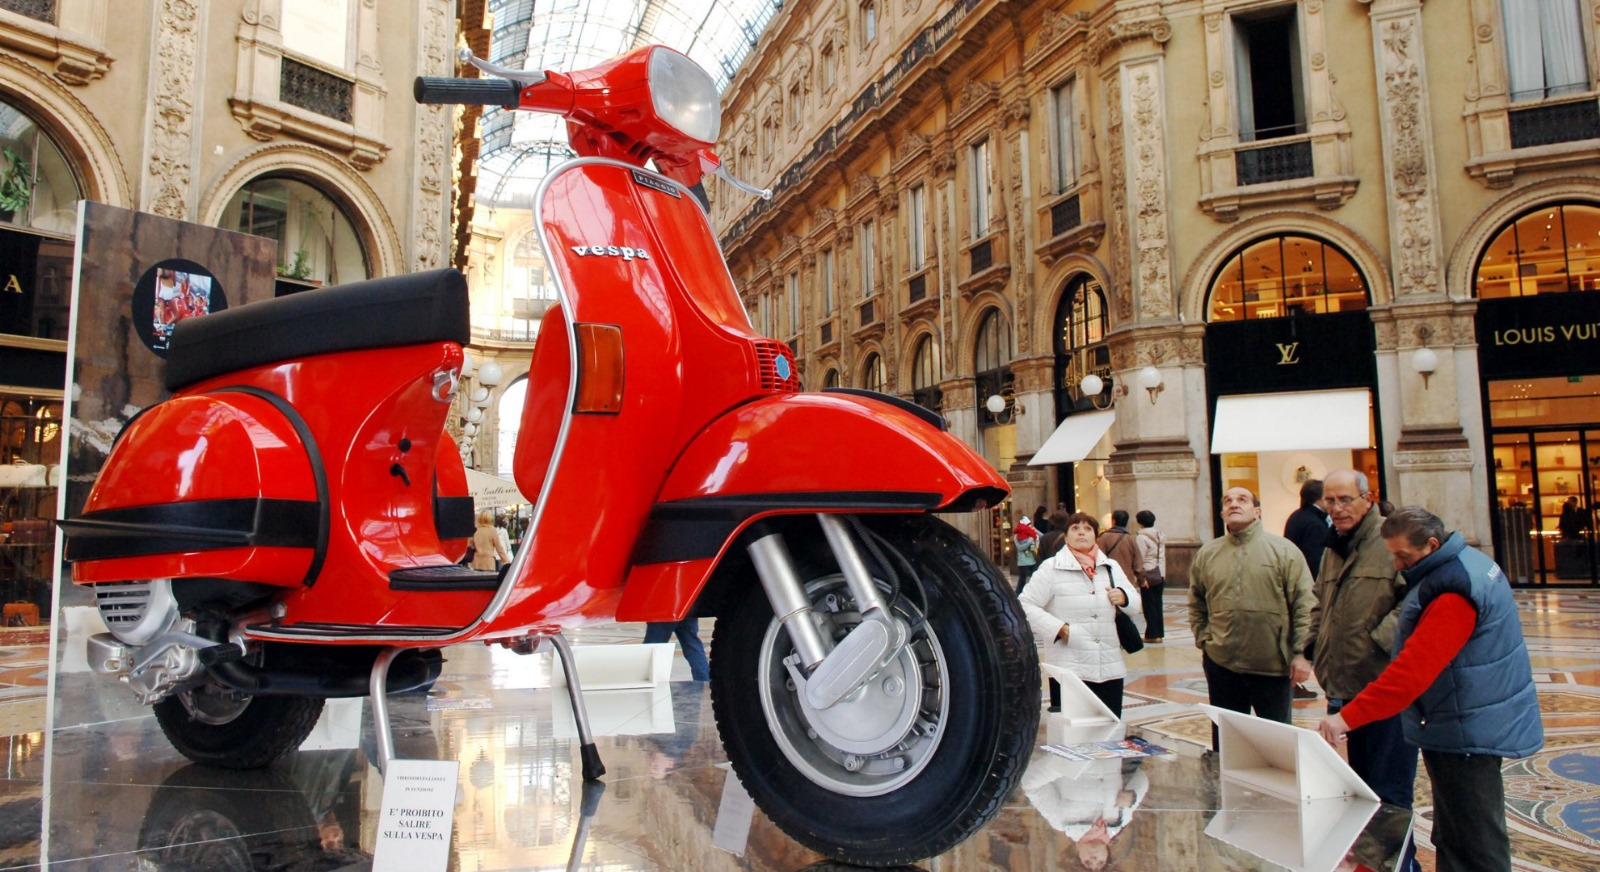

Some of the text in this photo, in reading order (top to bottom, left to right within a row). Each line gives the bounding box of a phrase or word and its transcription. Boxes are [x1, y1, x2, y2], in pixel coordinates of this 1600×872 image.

[638, 175, 676, 193] PIAGGIO
[571, 245, 650, 260] vespa
[4, 274, 23, 294] A
[1494, 326, 1556, 346] LOUIS
[1275, 341, 1300, 365] LV
[483, 486, 517, 495] Galleria
[400, 808, 444, 818] PROIBITO
[398, 819, 432, 829] SALIRE
[384, 830, 443, 841] SULLA VESPA
